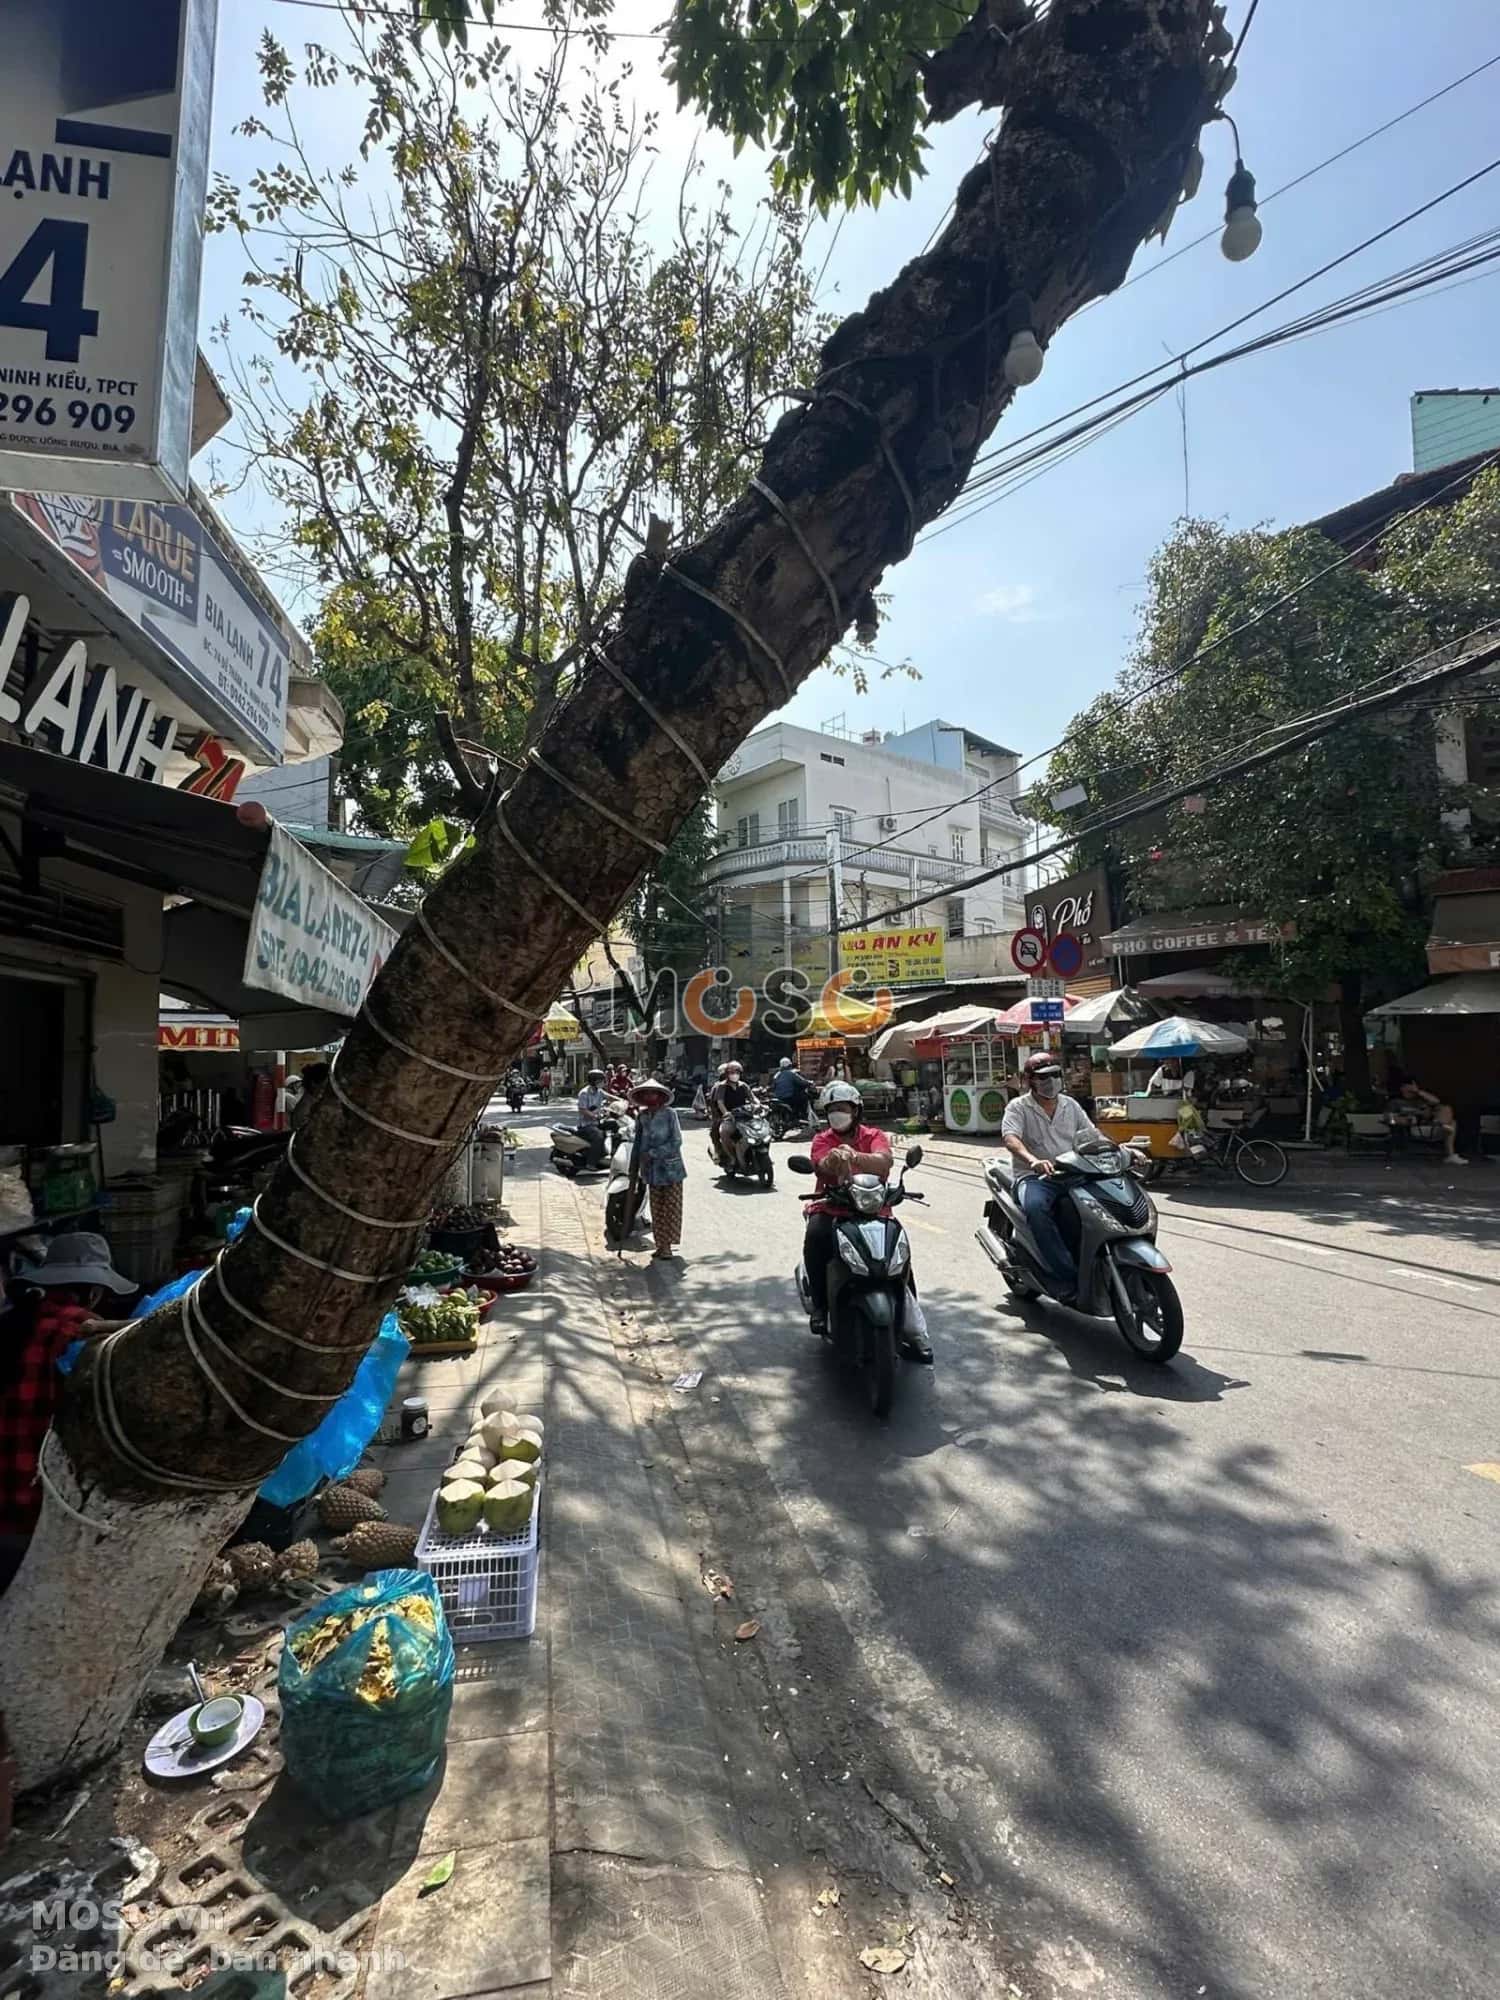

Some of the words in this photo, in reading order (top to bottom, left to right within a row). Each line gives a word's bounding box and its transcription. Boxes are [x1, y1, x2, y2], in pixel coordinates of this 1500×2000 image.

[0, 150, 111, 199] ẠNH
[46, 370, 92, 394] KIỂU,
[97, 378, 138, 396] TPCT
[68, 400, 135, 433] 909
[113, 499, 196, 583] LARUE
[122, 546, 185, 608] SMOOTH
[205, 594, 224, 638] BIA
[227, 620, 254, 671] LẠNH
[257, 628, 283, 709] 74
[259, 852, 302, 926] BIA
[1153, 932, 1219, 951] COFFEE
[1225, 930, 1240, 944] &
[288, 948, 328, 993] 0942
